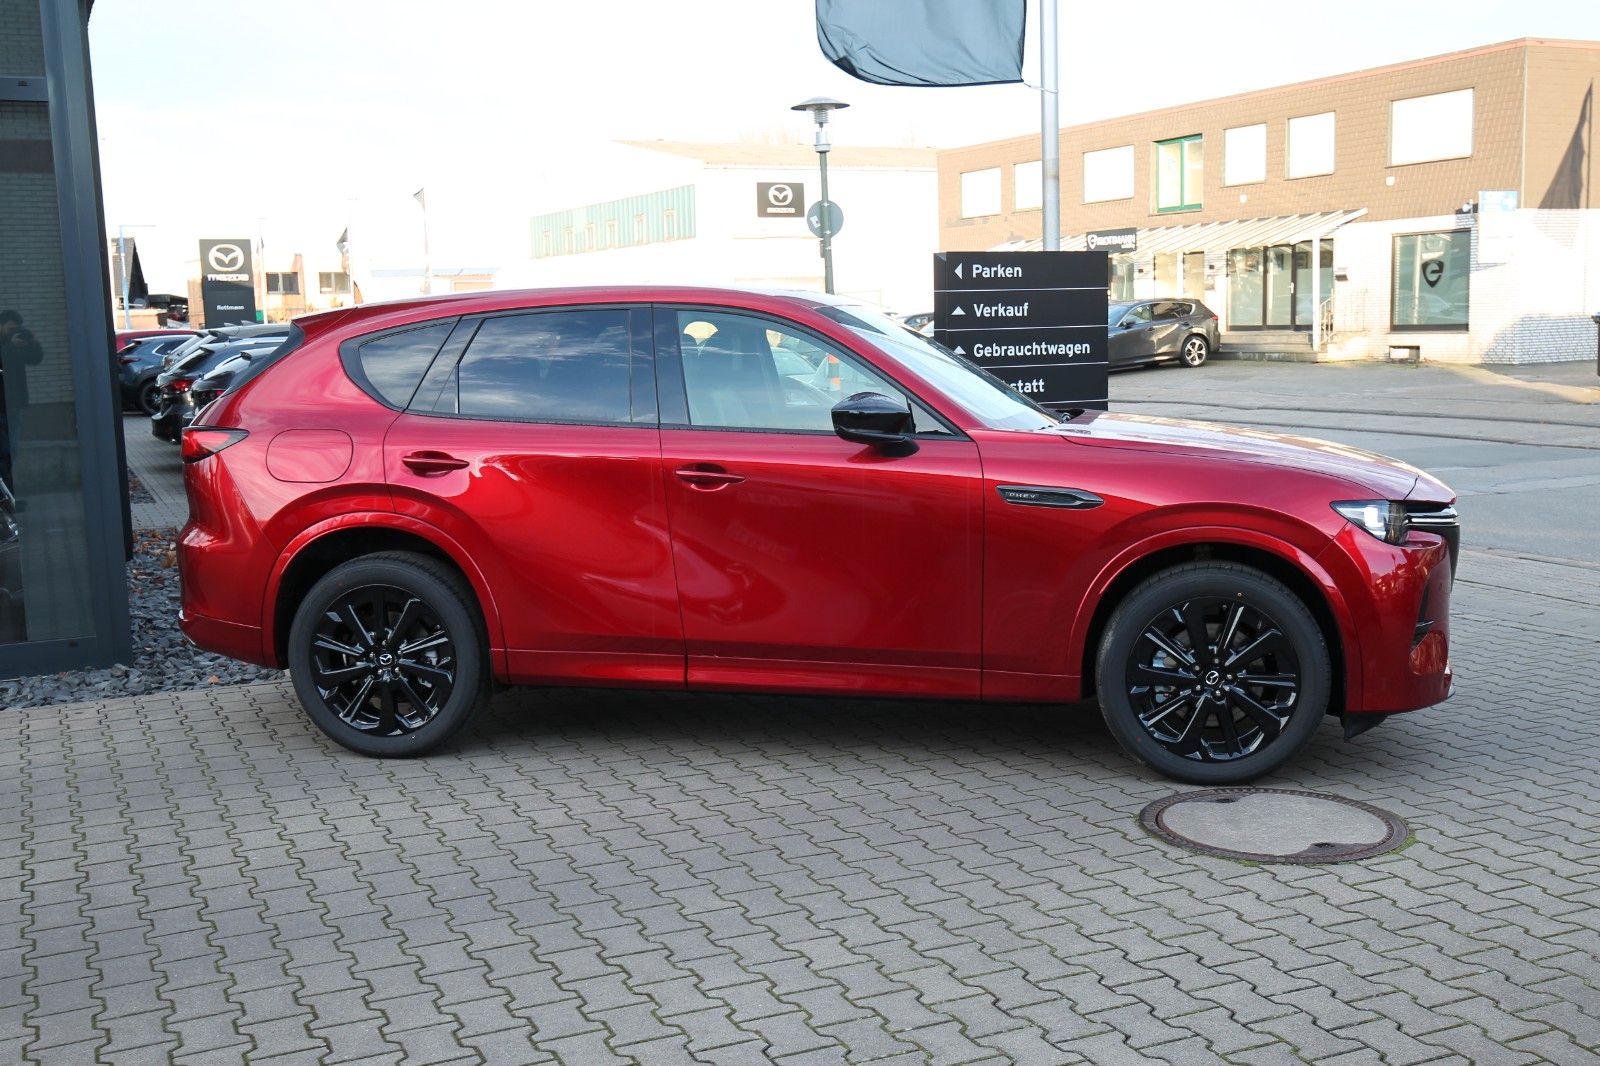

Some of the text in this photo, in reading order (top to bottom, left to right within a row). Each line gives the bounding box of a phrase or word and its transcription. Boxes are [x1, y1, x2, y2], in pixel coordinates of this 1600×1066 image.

[972, 264, 1022, 278] Parken
[973, 302, 1029, 317] Verkauf
[973, 341, 1091, 358] Gebrauchtwagen
[1003, 379, 1045, 393] statt
